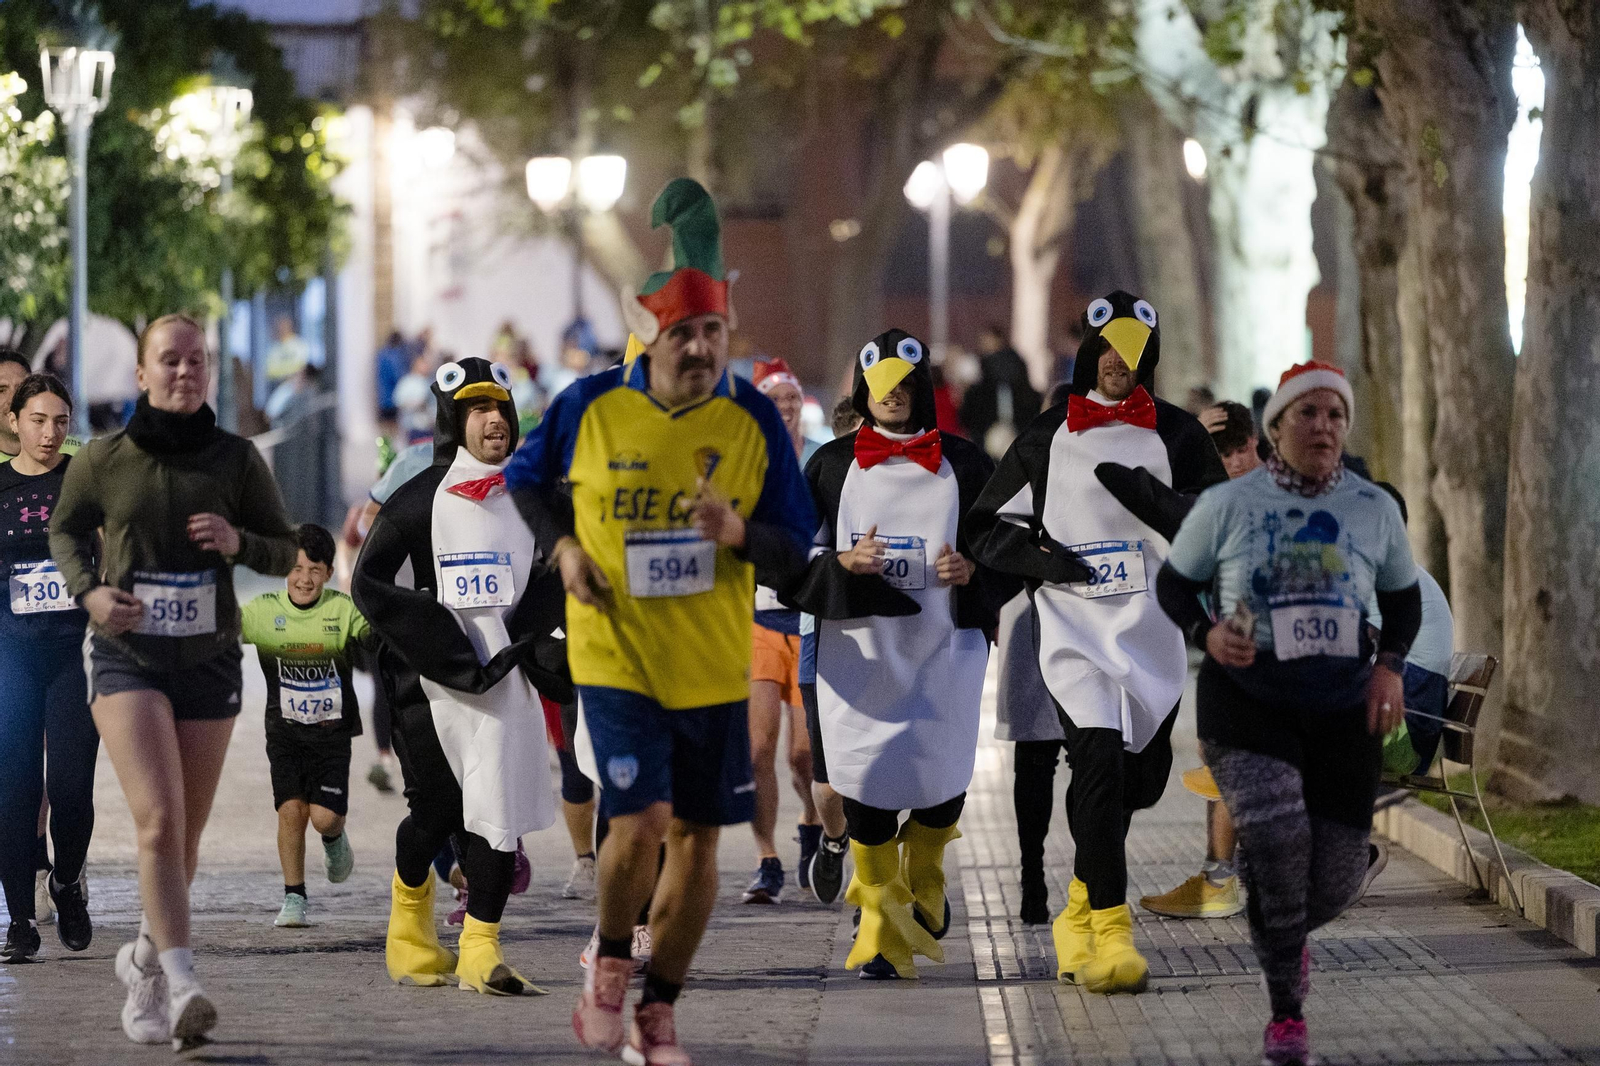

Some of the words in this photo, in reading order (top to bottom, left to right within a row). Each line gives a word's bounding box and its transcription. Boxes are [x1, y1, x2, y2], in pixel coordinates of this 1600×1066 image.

[3, 494, 53, 509] UNDE
[7, 527, 49, 536] RMO
[649, 557, 699, 582] 594
[883, 559, 909, 578] 20
[456, 574, 498, 596] 916
[151, 599, 199, 622] 595
[1293, 617, 1339, 641] 630
[275, 656, 339, 680] INNOVA
[287, 697, 334, 715] 1478
